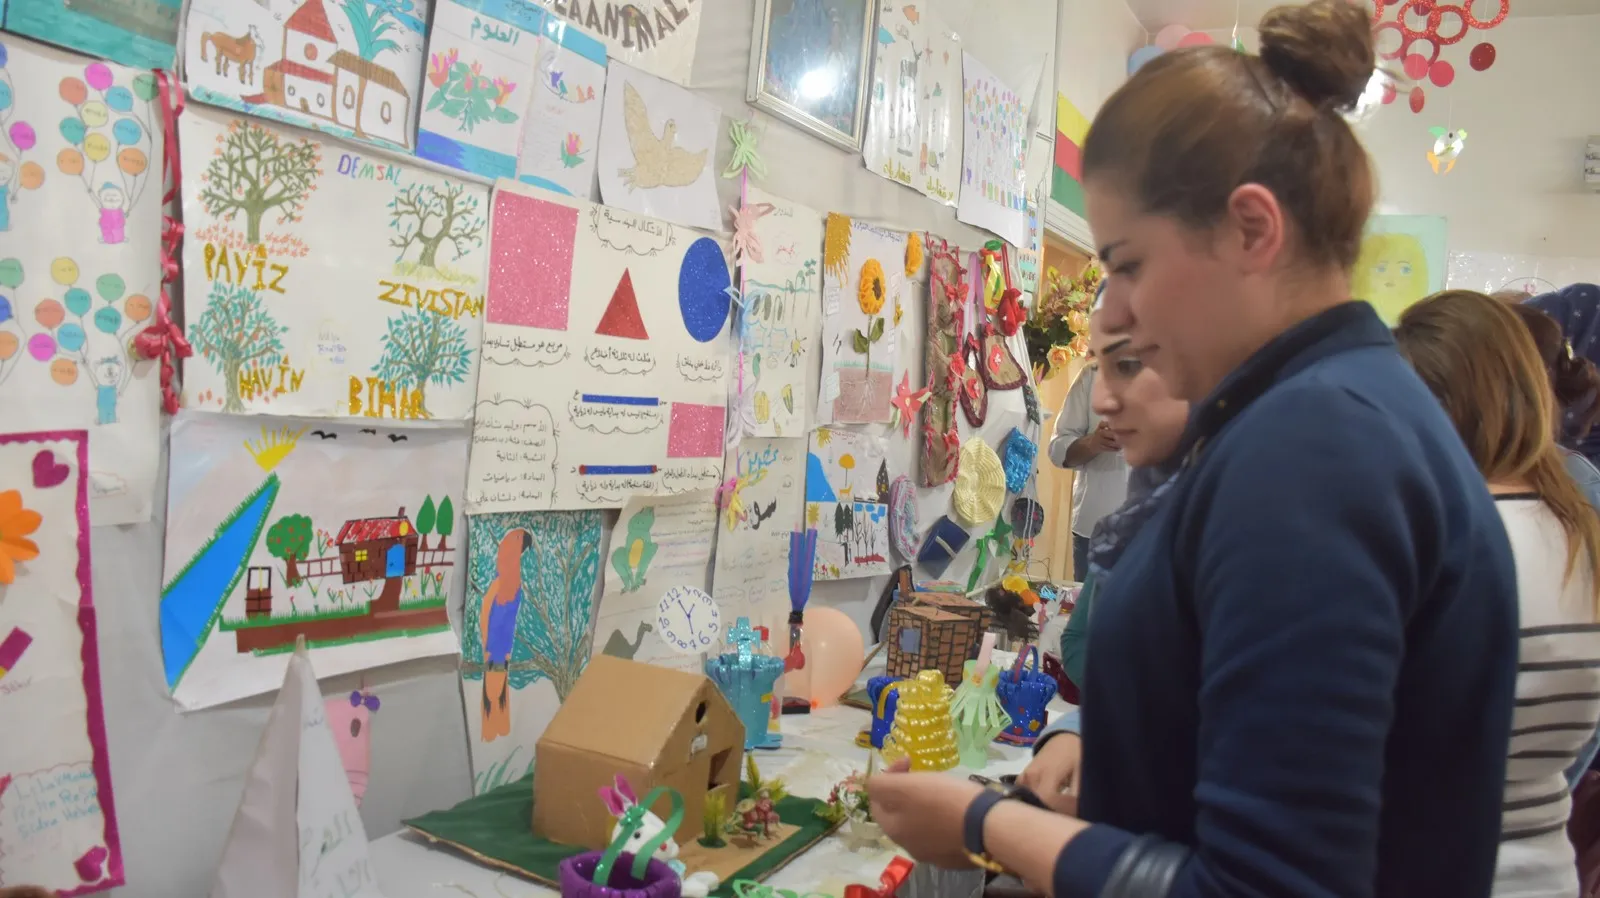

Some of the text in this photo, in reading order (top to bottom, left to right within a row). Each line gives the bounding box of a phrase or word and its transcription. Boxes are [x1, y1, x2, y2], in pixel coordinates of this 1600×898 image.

[470, 15, 520, 46] العلوم
[378, 280, 484, 320] ZIVISTAN
[349, 375, 430, 421] BIHAR
[667, 588, 681, 602] 12
[682, 585, 691, 596] 1
[693, 589, 702, 598] 2
[702, 596, 713, 606] 3
[708, 622, 718, 633] 5
[666, 630, 677, 643] 9
[698, 630, 711, 645] 6
[677, 639, 688, 649] 8
